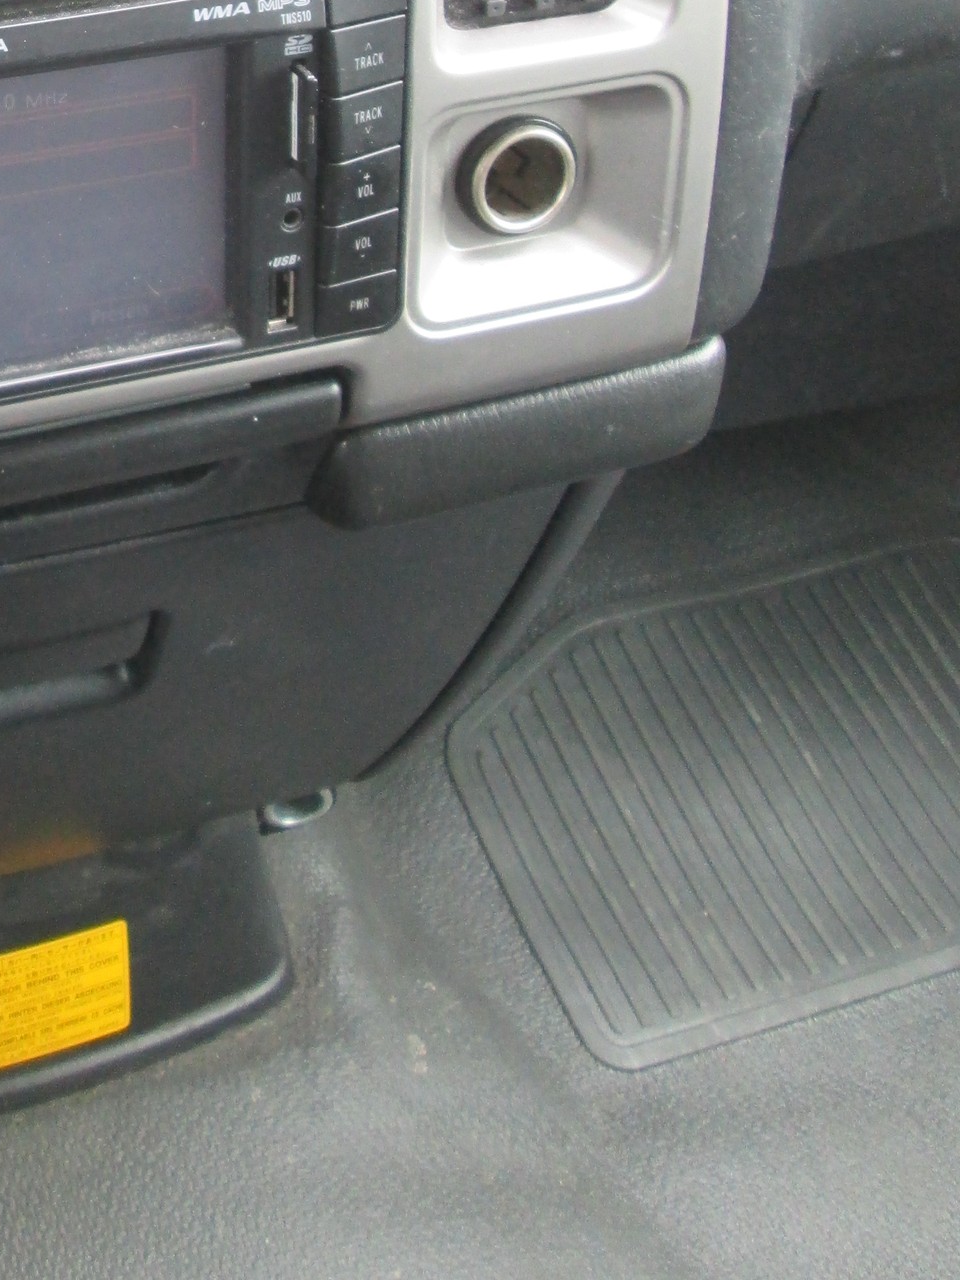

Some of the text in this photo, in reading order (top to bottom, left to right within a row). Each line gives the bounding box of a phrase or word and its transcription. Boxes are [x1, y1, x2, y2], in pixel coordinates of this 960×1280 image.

[193, 1, 250, 22] WMA
[280, 11, 312, 25] TNS510
[354, 52, 384, 70] TRACK
[354, 106, 383, 124] TRACK
[285, 191, 302, 204] AUX
[358, 184, 375, 199] VOL
[355, 236, 372, 251] VOL
[273, 254, 298, 268] USB
[350, 297, 370, 312] PWR
